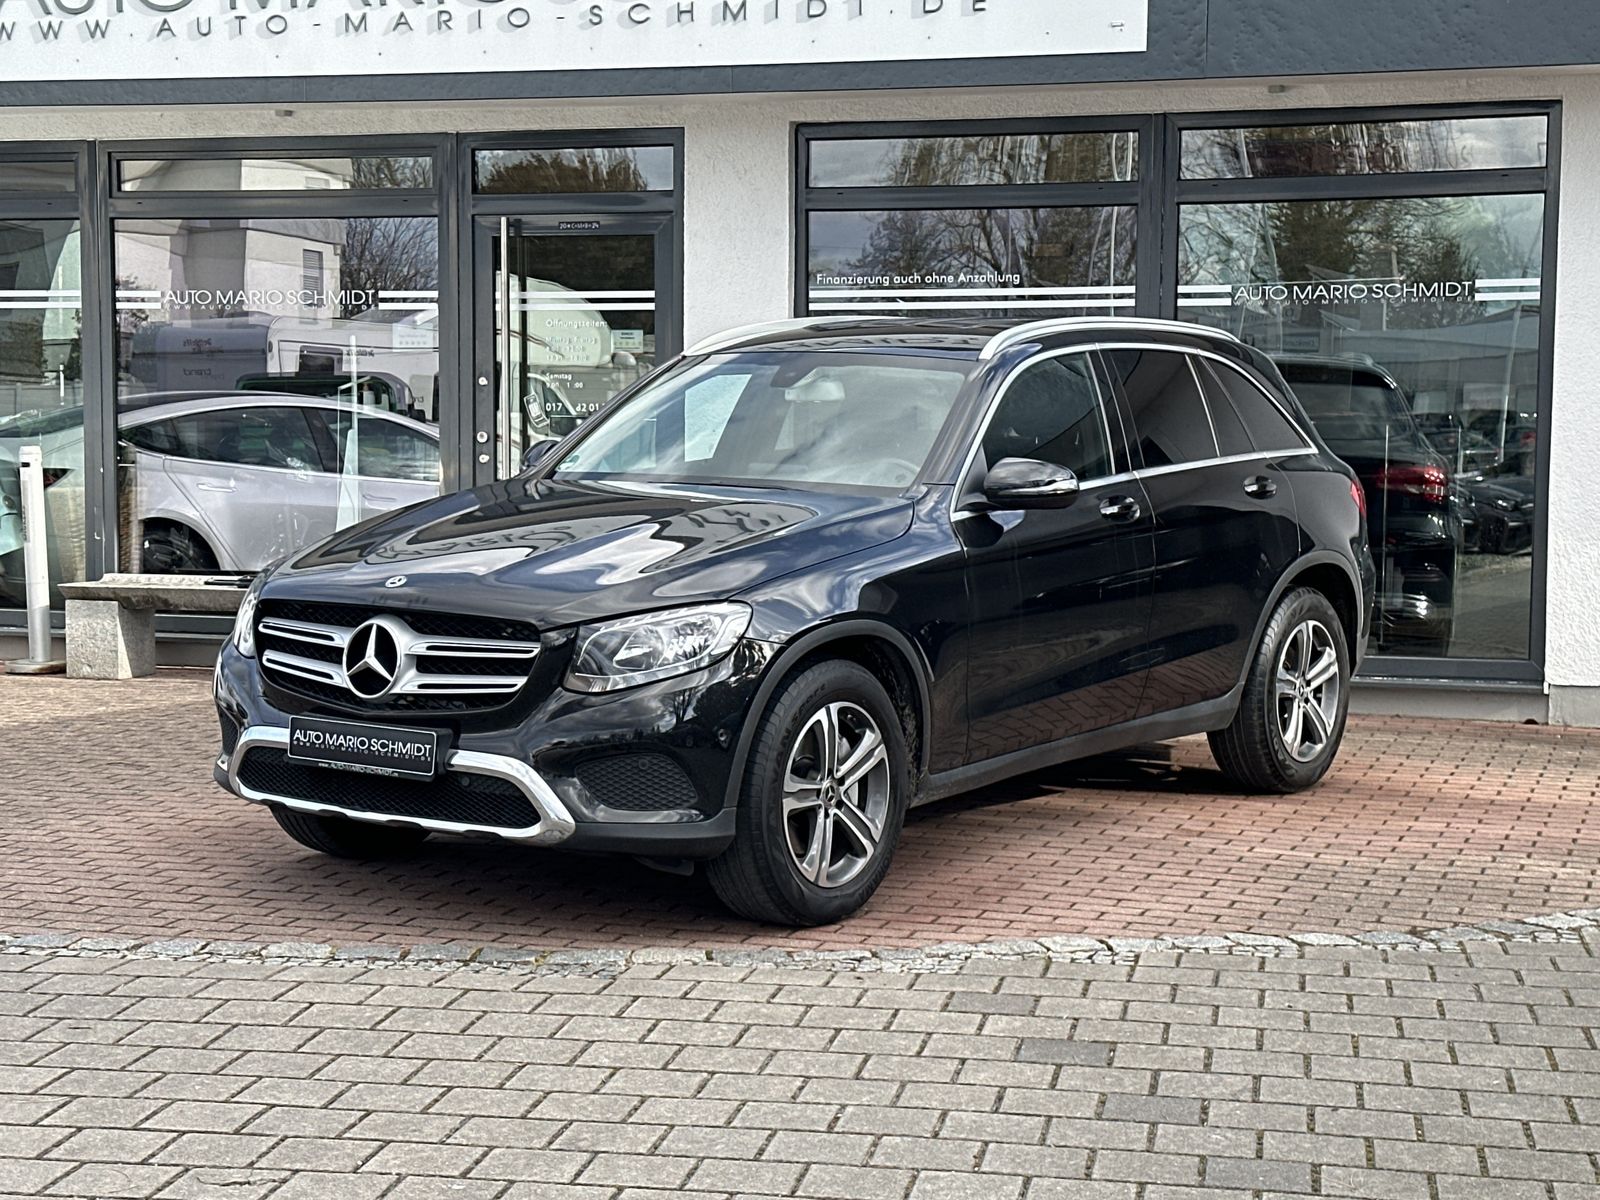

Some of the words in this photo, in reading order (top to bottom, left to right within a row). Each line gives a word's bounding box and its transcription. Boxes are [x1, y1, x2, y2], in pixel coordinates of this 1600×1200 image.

[816, 273, 889, 286] Finanzierung
[893, 272, 921, 284] auch
[925, 272, 954, 284] ohne
[958, 271, 1020, 285] Anzahlung
[163, 290, 212, 305] AUTO
[216, 290, 284, 305] MARIO
[286, 290, 375, 305] SCHMIDT
[1234, 285, 1288, 301] AUTO
[1293, 283, 1368, 300] MARIO
[1371, 281, 1472, 298] SCHMIDT
[293, 728, 324, 744] AUTO
[325, 732, 369, 751] MARIO
[370, 738, 432, 757] SCHMIDT
